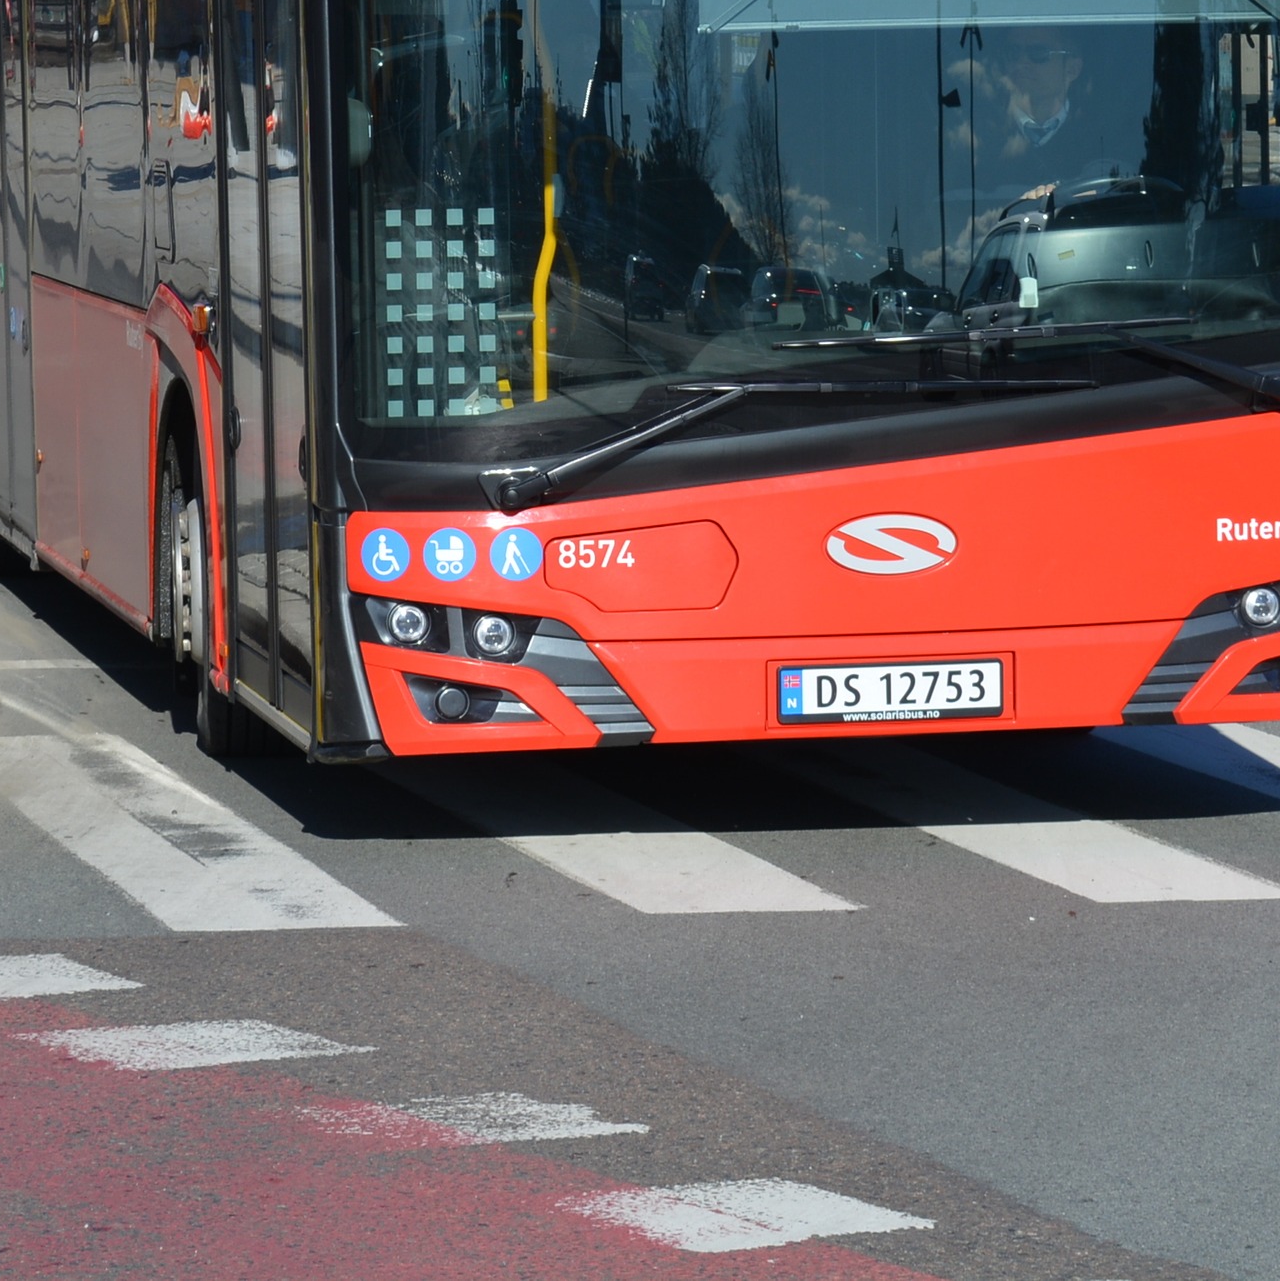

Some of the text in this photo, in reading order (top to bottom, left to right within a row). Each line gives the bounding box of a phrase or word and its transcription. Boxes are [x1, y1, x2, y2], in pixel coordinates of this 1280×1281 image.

[558, 539, 636, 569] 8574
[816, 669, 986, 708] DS 12753
[787, 698, 797, 708] N
[842, 709, 941, 722] www.solarisbus.no
